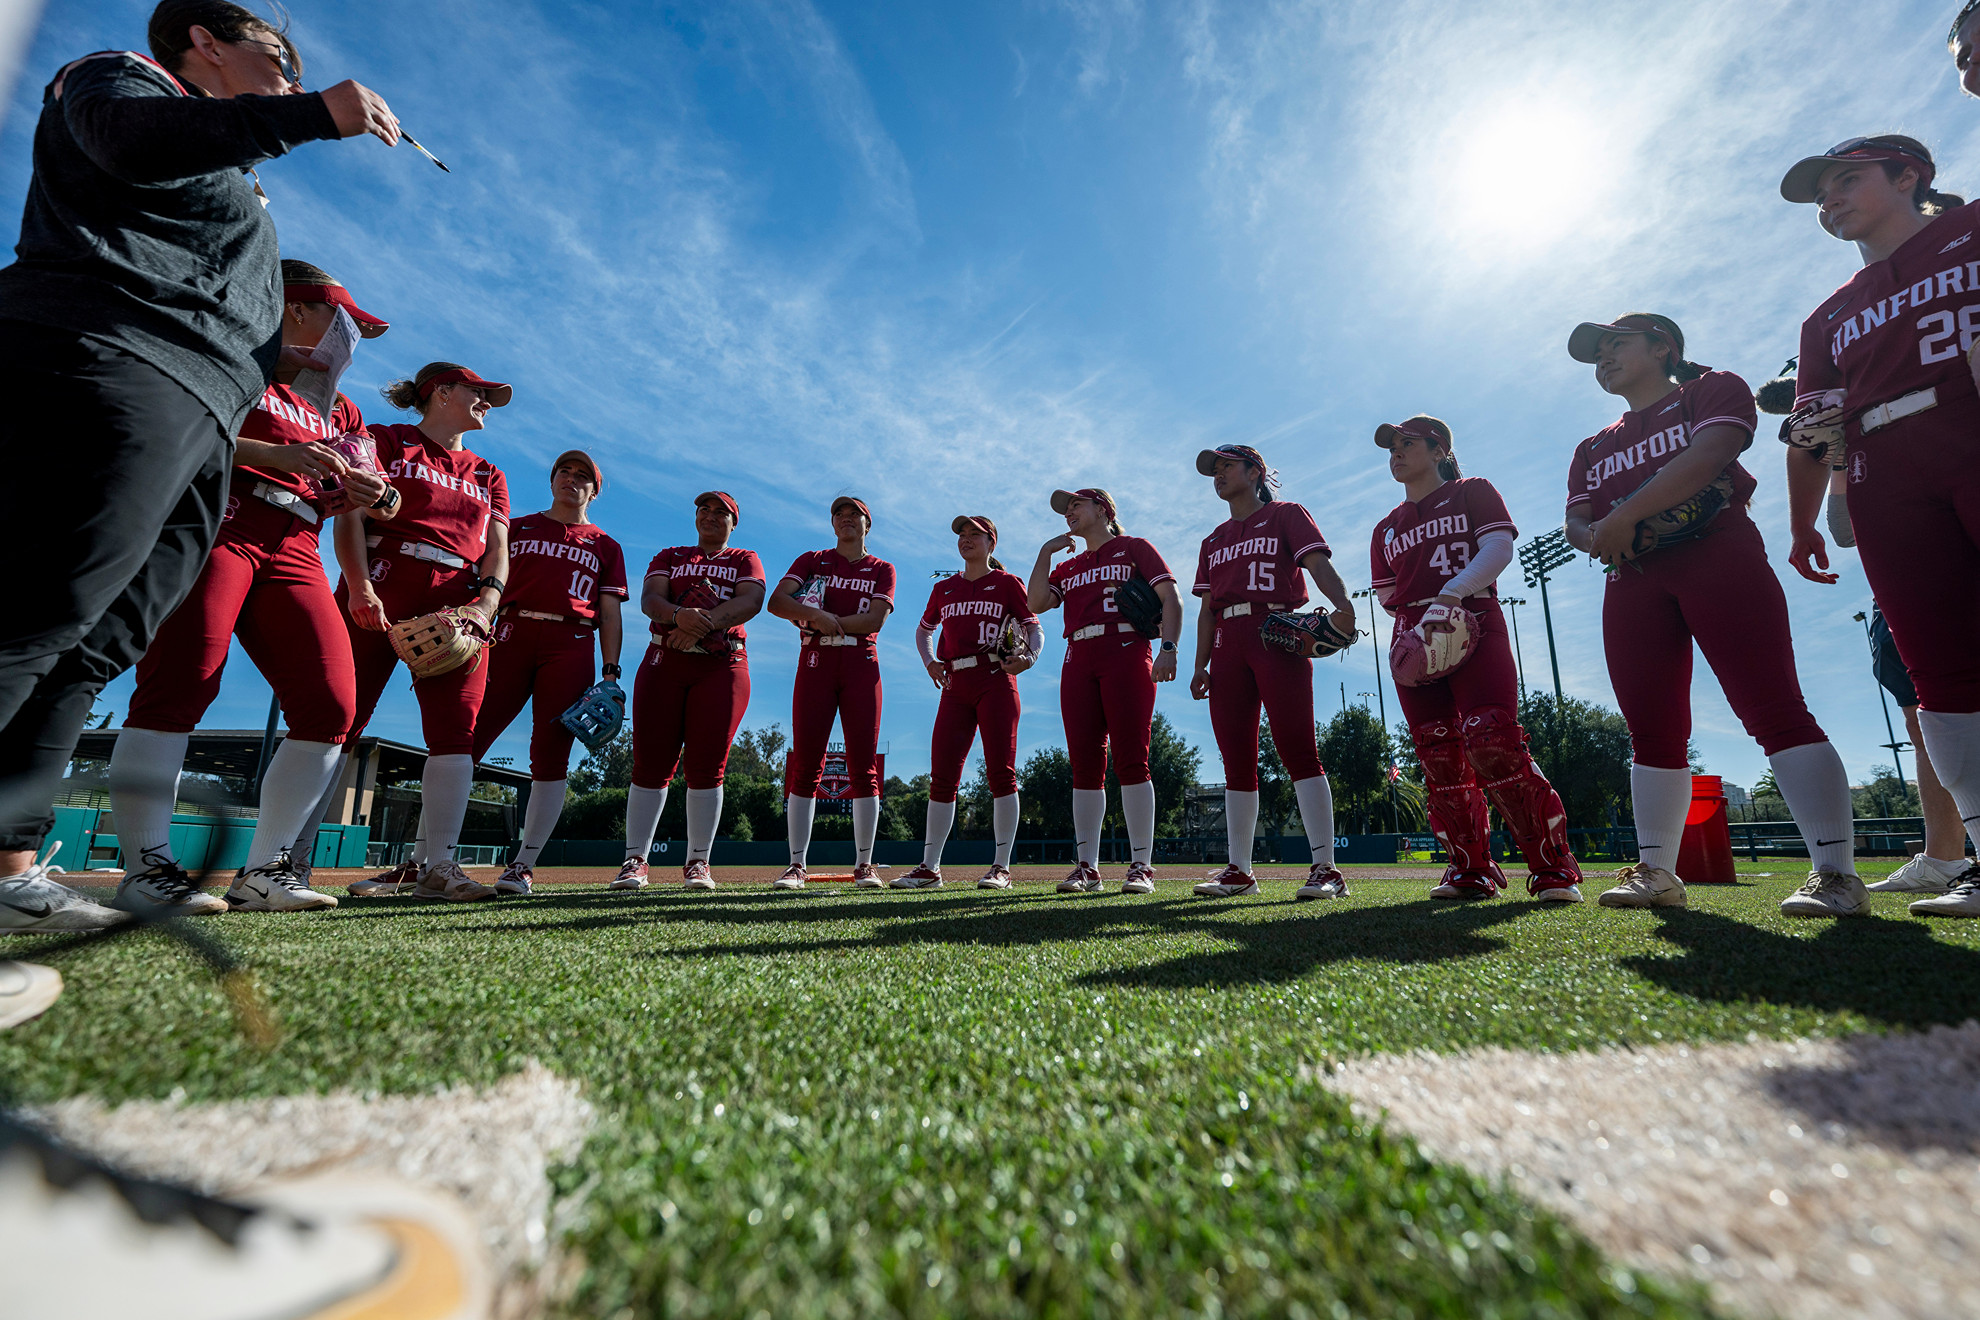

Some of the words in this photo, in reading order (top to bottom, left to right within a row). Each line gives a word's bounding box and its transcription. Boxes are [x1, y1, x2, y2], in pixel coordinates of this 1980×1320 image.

[1586, 421, 1693, 491] STANFOR
[389, 459, 490, 509] STANFOR
[510, 540, 600, 574] STANFORD
[1208, 537, 1278, 571] TANFORD
[1429, 541, 1470, 576] 43
[568, 569, 594, 602] 10
[670, 563, 738, 583] TANFORD
[1061, 564, 1131, 595] STANFORD
[1247, 561, 1275, 591] 15
[941, 601, 1003, 621] STANFORD
[427, 650, 451, 666] A2000
[650, 842, 668, 853] 00
